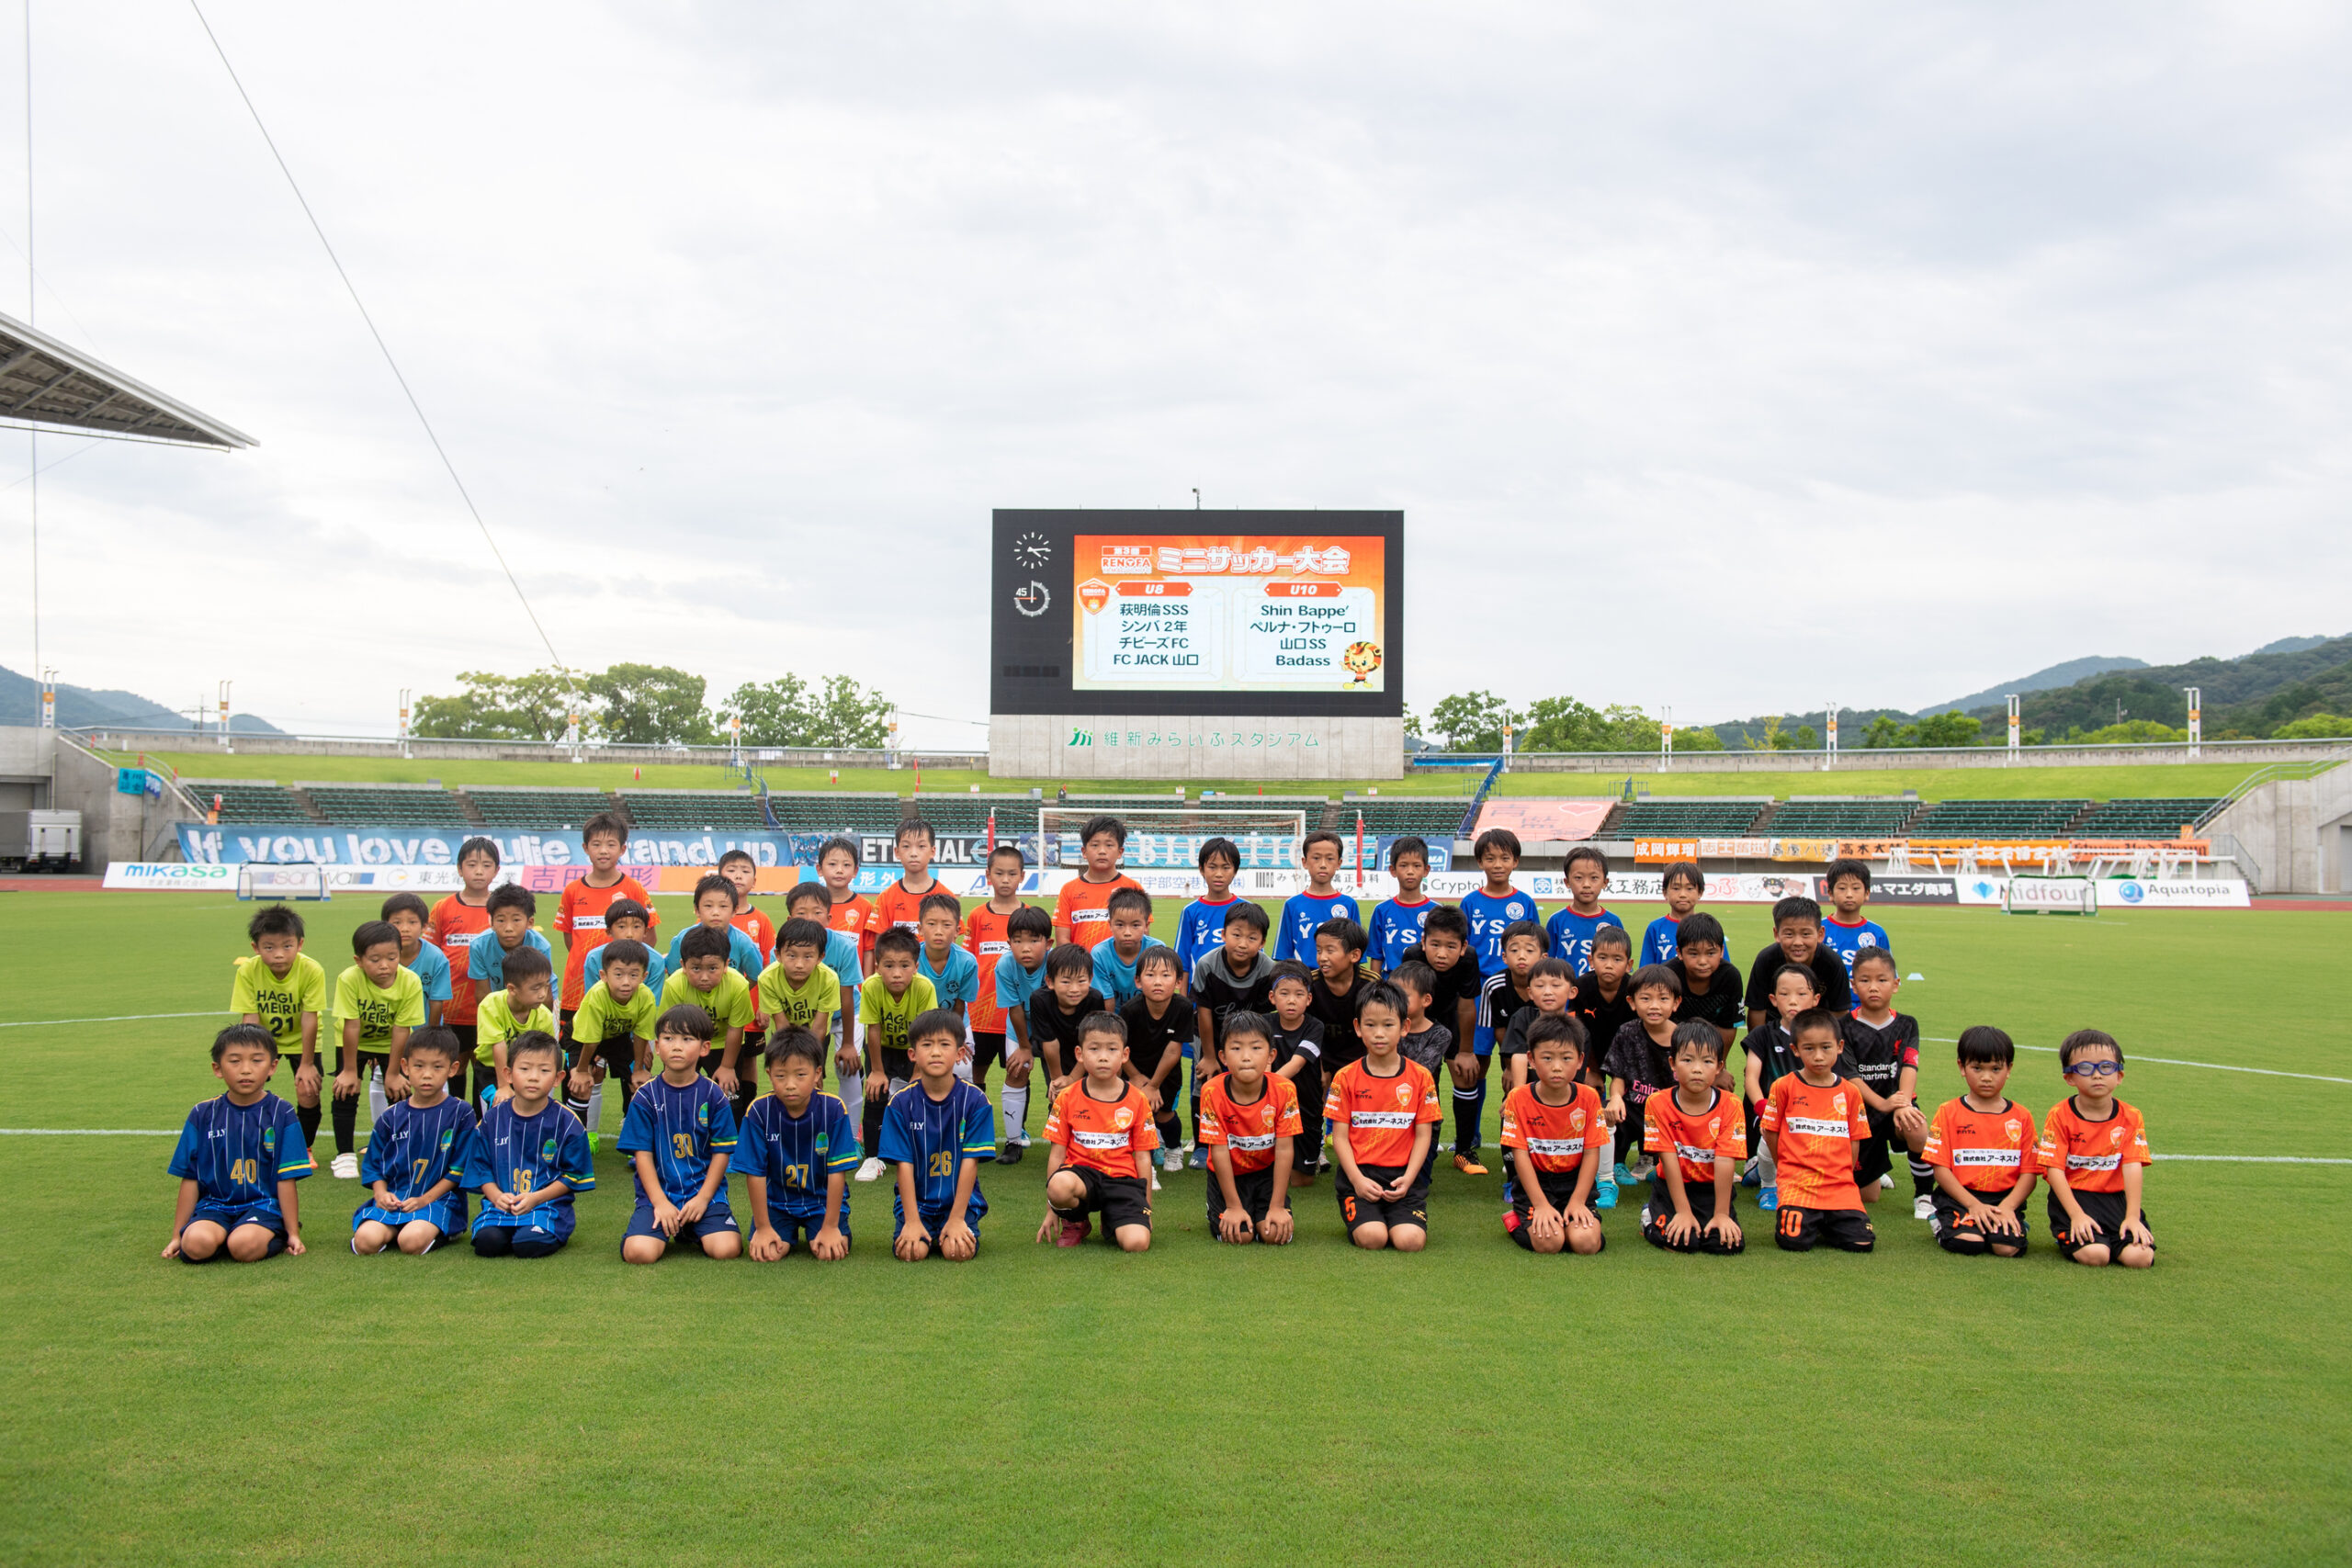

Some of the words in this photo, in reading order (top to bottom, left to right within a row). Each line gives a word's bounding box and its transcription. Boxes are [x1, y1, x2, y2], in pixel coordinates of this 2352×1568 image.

[1102, 558, 1150, 568] RENOFA
[1159, 547, 1349, 573] ミニサッカー大会
[1014, 588, 1027, 597] 45
[1145, 584, 1165, 594] U8
[1290, 584, 1317, 595] U10
[1261, 604, 1292, 616] Shin
[1114, 654, 1131, 665] FC
[1134, 654, 1169, 665] JACK
[1172, 654, 1199, 666] 山口
[1275, 655, 1330, 666] Badass
[1103, 731, 1318, 747] 維新みらいふスタジアム
[238, 836, 337, 863] you
[346, 833, 452, 865] love
[1883, 883, 1953, 896] マエダ商事
[2148, 884, 2231, 897] Aquatopia
[257, 990, 293, 1003] HAGI
[357, 999, 390, 1014] HAGI
[269, 1017, 294, 1038] 21
[361, 1025, 390, 1038] 25
[886, 1034, 908, 1046] 19
[673, 1133, 694, 1159] 30
[930, 1150, 953, 1178] 26
[230, 1158, 257, 1185] 40
[786, 1164, 809, 1190] 27
[1344, 1196, 1357, 1222] 5
[1780, 1209, 1803, 1237] 10
